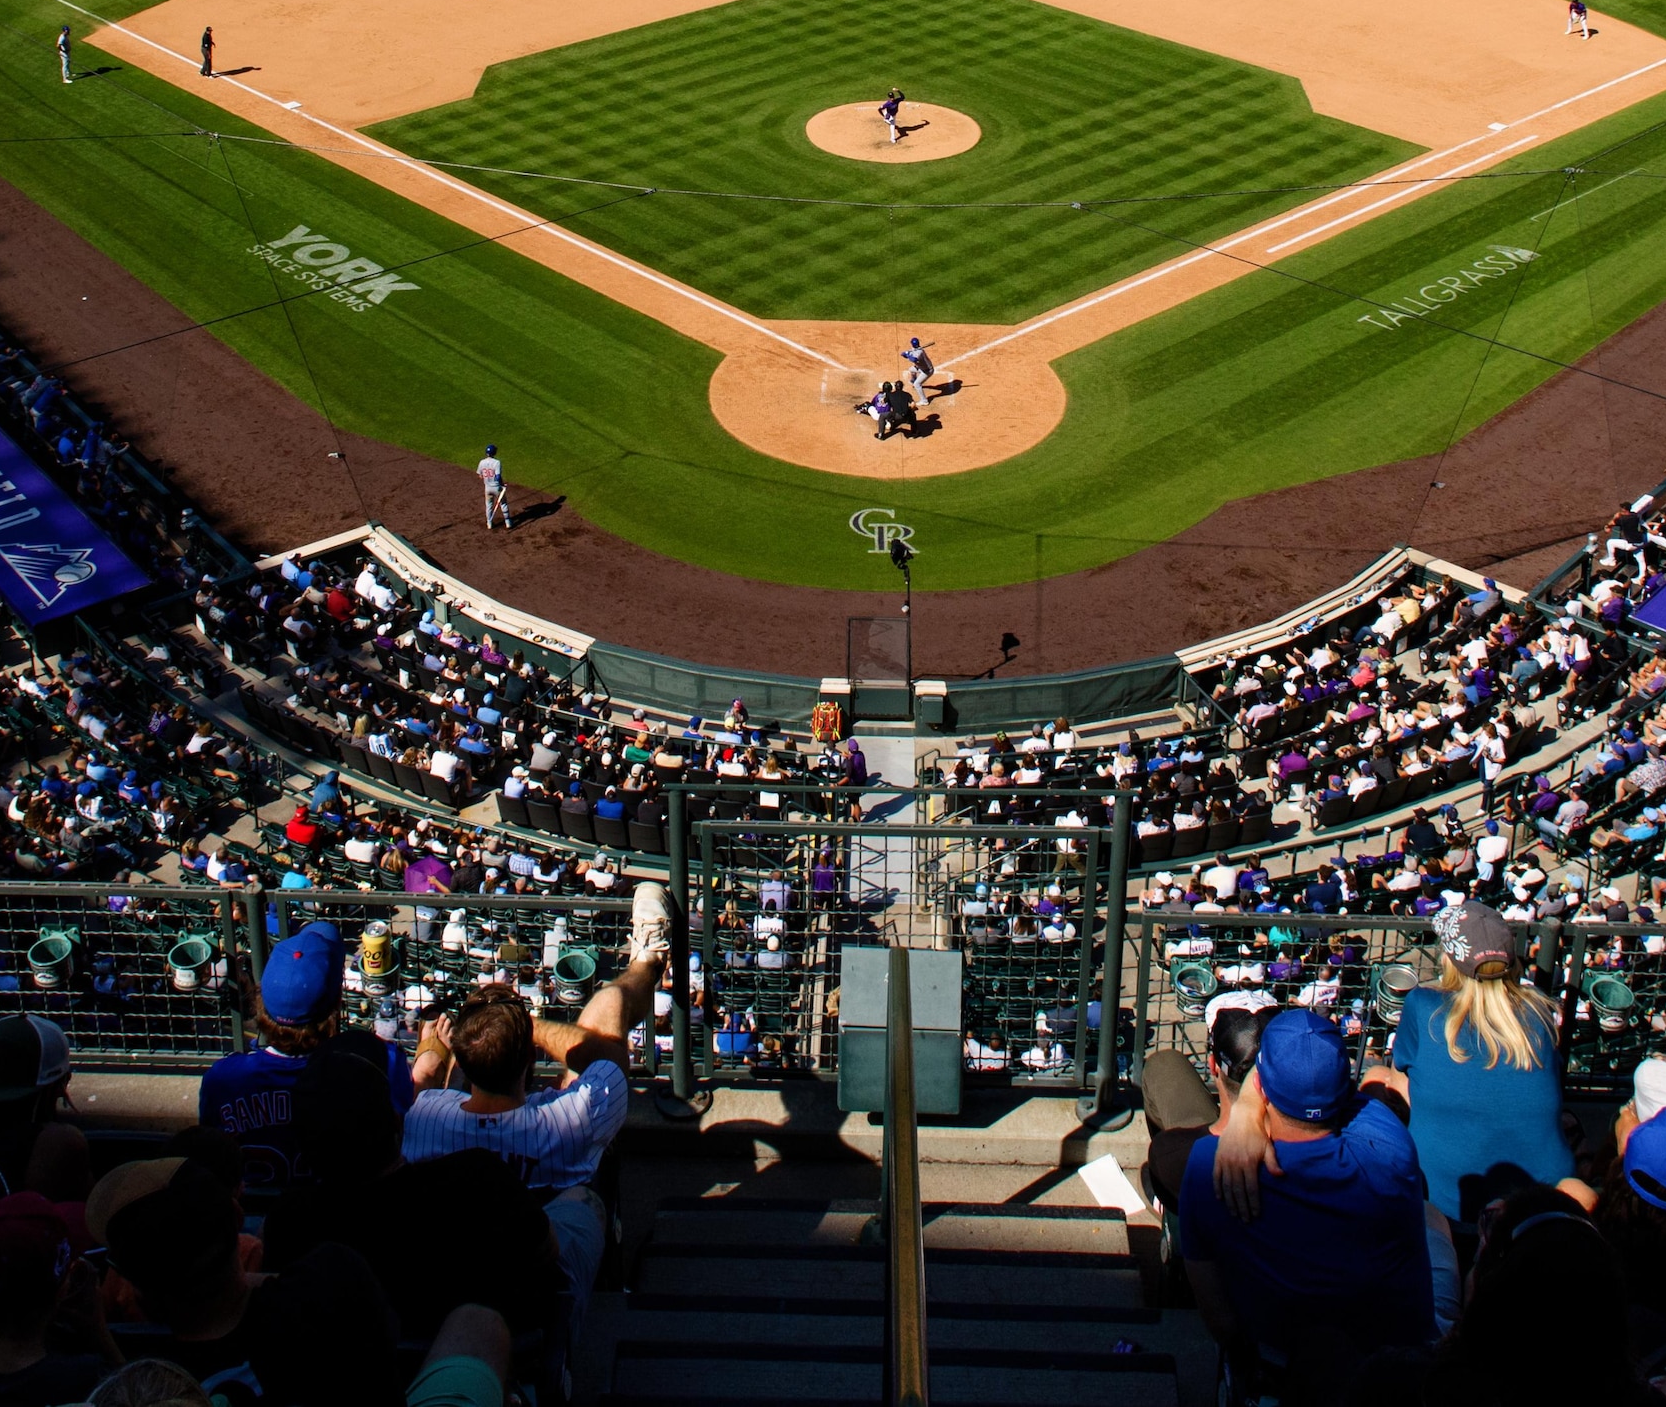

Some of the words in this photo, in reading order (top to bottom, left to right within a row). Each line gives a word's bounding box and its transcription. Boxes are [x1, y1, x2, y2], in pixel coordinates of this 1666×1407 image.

[246, 244, 302, 273] SPACE
[294, 271, 372, 312] SYSTEMS
[267, 225, 421, 305] YORK
[1357, 255, 1518, 330] TALLGRASS
